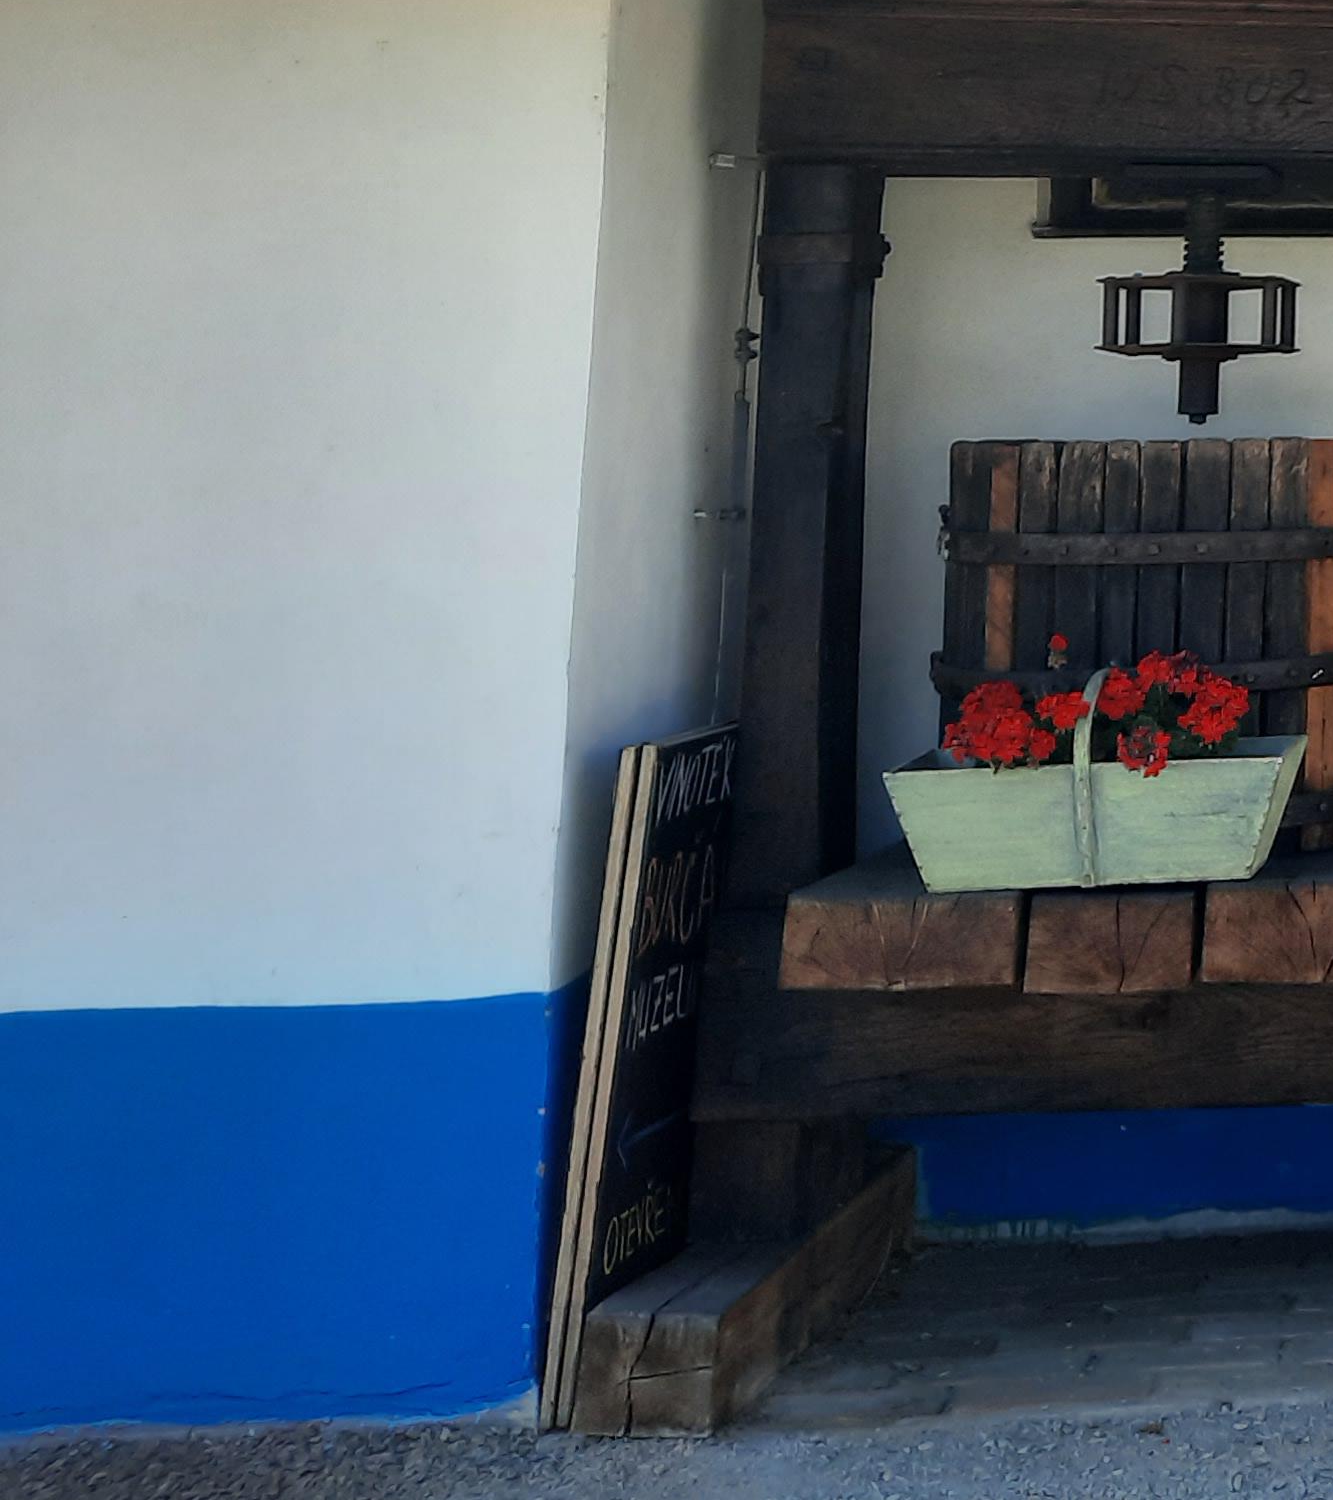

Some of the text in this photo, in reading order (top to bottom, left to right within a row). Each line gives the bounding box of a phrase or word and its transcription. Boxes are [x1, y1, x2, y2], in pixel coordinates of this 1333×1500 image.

[655, 734, 737, 828] VINOTÉK
[634, 811, 723, 959] BURČÁ
[602, 1177, 672, 1277] OTEVŘE
